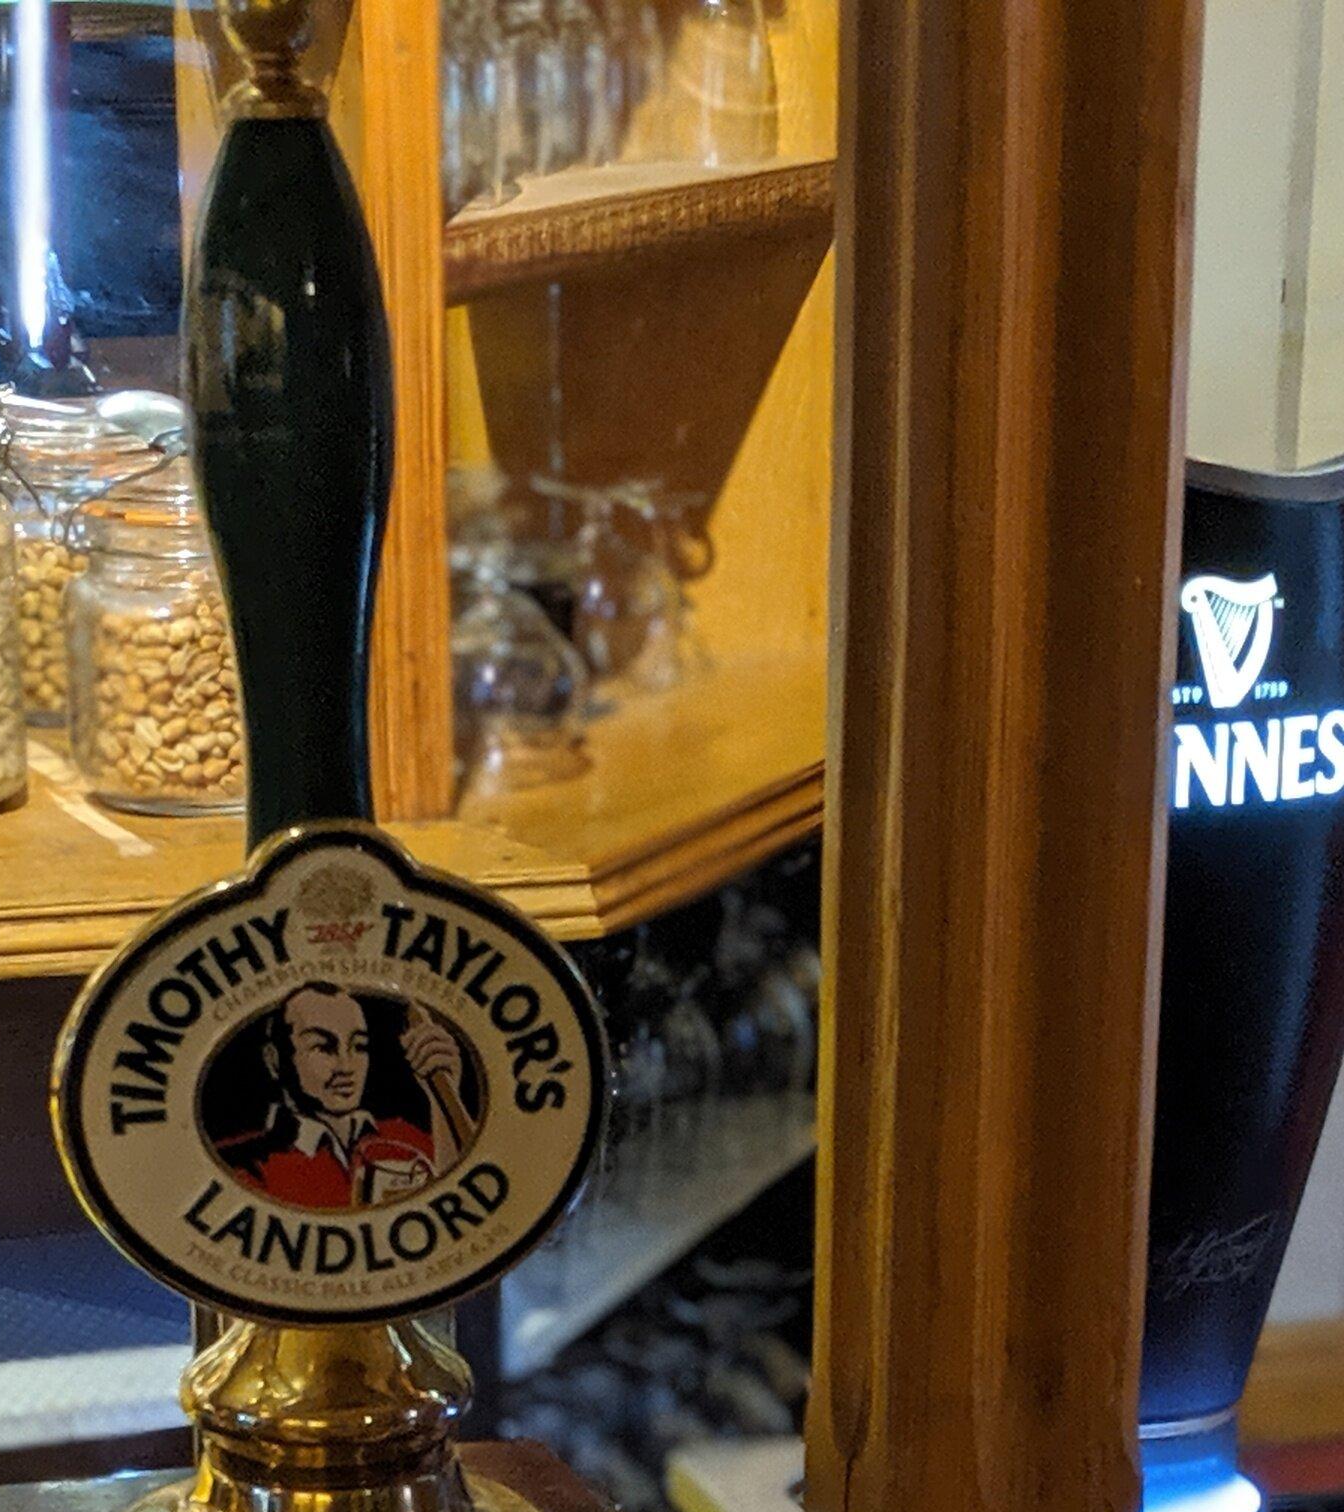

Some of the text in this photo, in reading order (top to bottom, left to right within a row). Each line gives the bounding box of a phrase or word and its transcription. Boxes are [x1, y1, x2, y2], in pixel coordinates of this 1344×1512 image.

[110, 903, 568, 1135] TIMOTHY TAYLOR'S
[183, 1160, 511, 1276] LANDLORD
